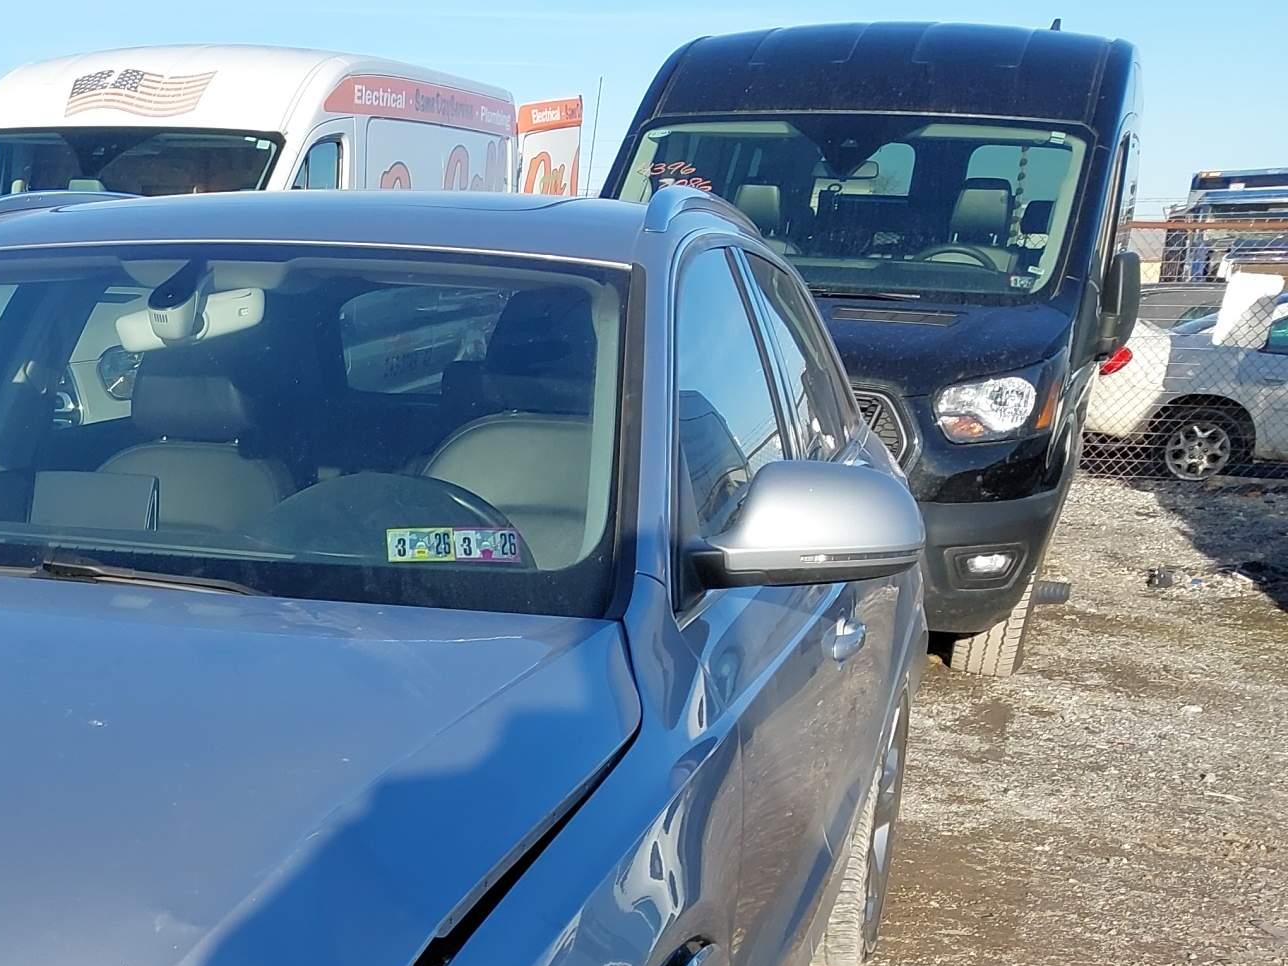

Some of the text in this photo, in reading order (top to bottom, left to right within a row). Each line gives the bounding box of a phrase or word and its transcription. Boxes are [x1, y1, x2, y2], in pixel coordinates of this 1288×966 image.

[354, 84, 405, 109] Electrical
[531, 105, 561, 124] Electrical
[397, 532, 451, 557] 3 26
[462, 532, 517, 556] 3 26
